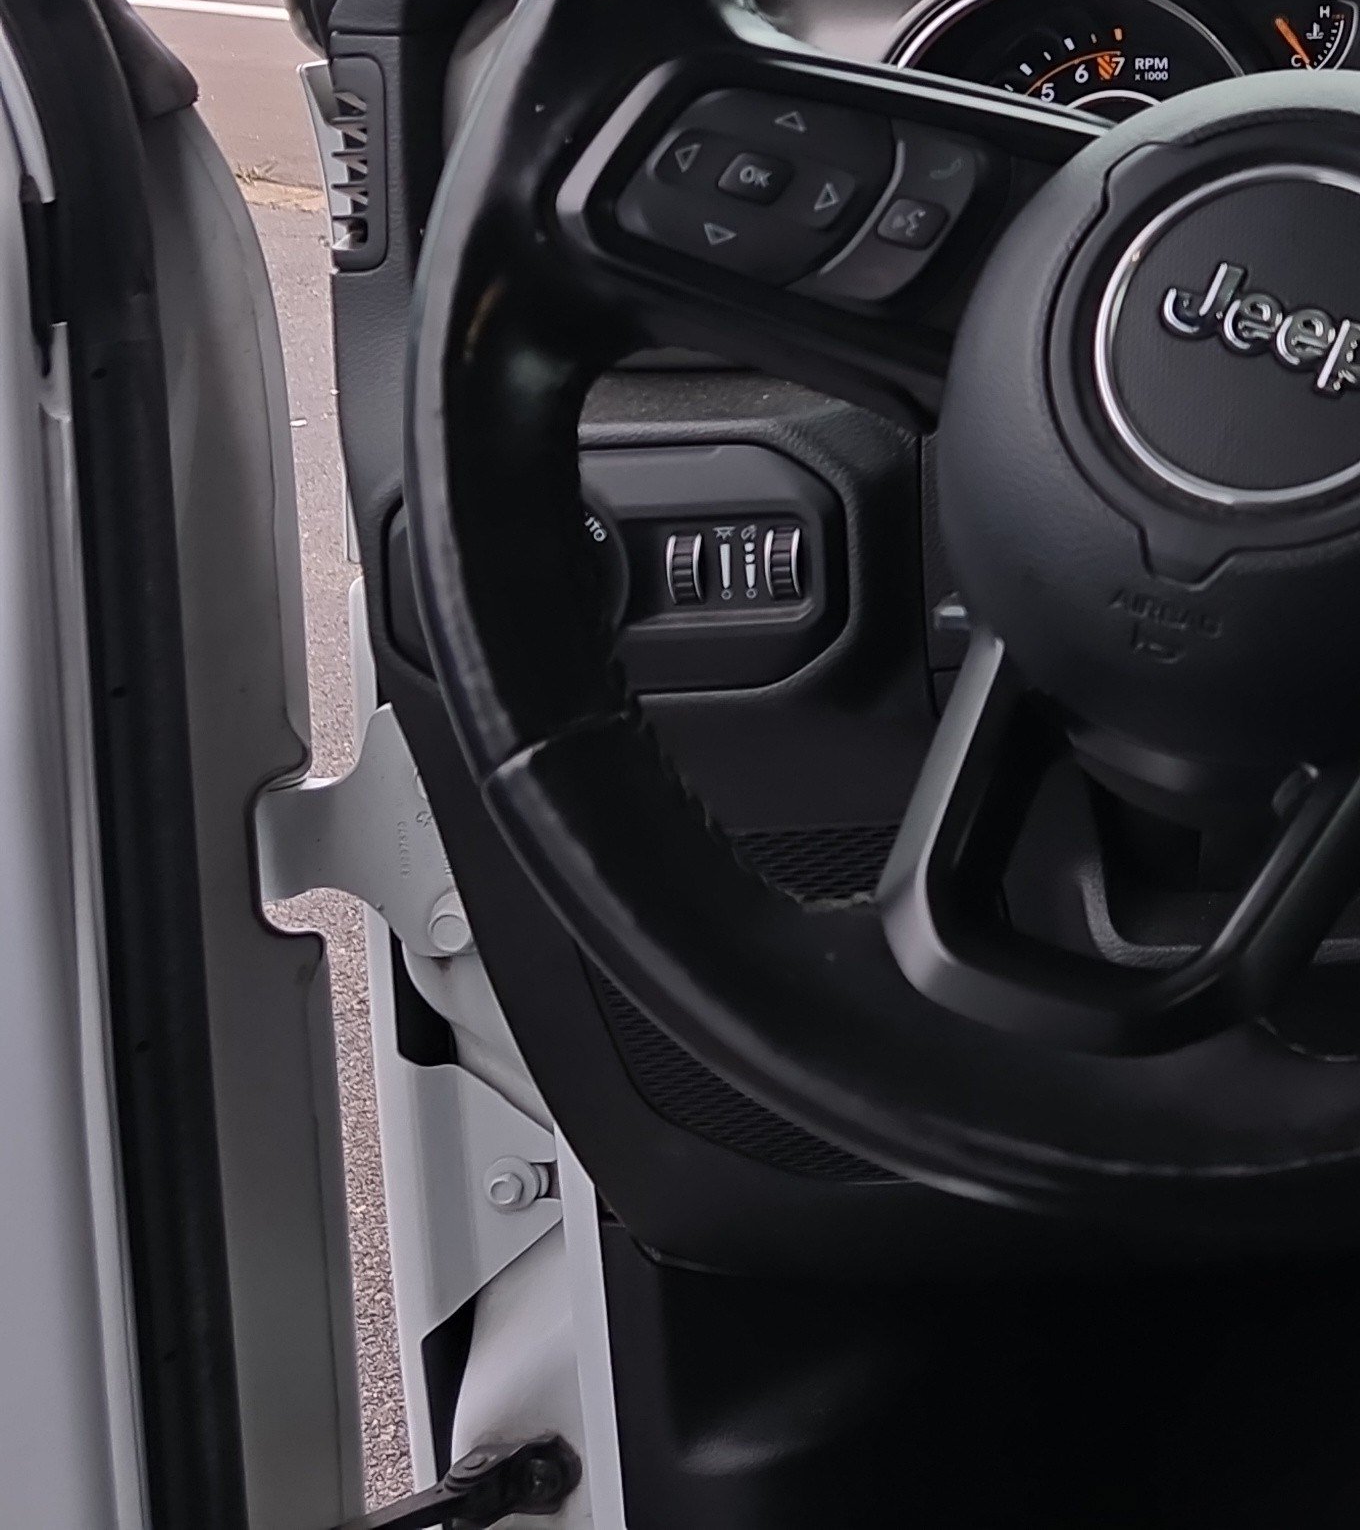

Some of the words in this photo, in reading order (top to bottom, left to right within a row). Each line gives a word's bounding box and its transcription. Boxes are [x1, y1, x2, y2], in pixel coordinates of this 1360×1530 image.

[1319, 6, 1330, 18] H
[1111, 57, 1125, 76] 7
[1135, 57, 1168, 70] RPM
[1074, 64, 1089, 83] 6
[1145, 71, 1168, 80] 1000
[1040, 82, 1055, 102] 5
[739, 165, 771, 188] OK
